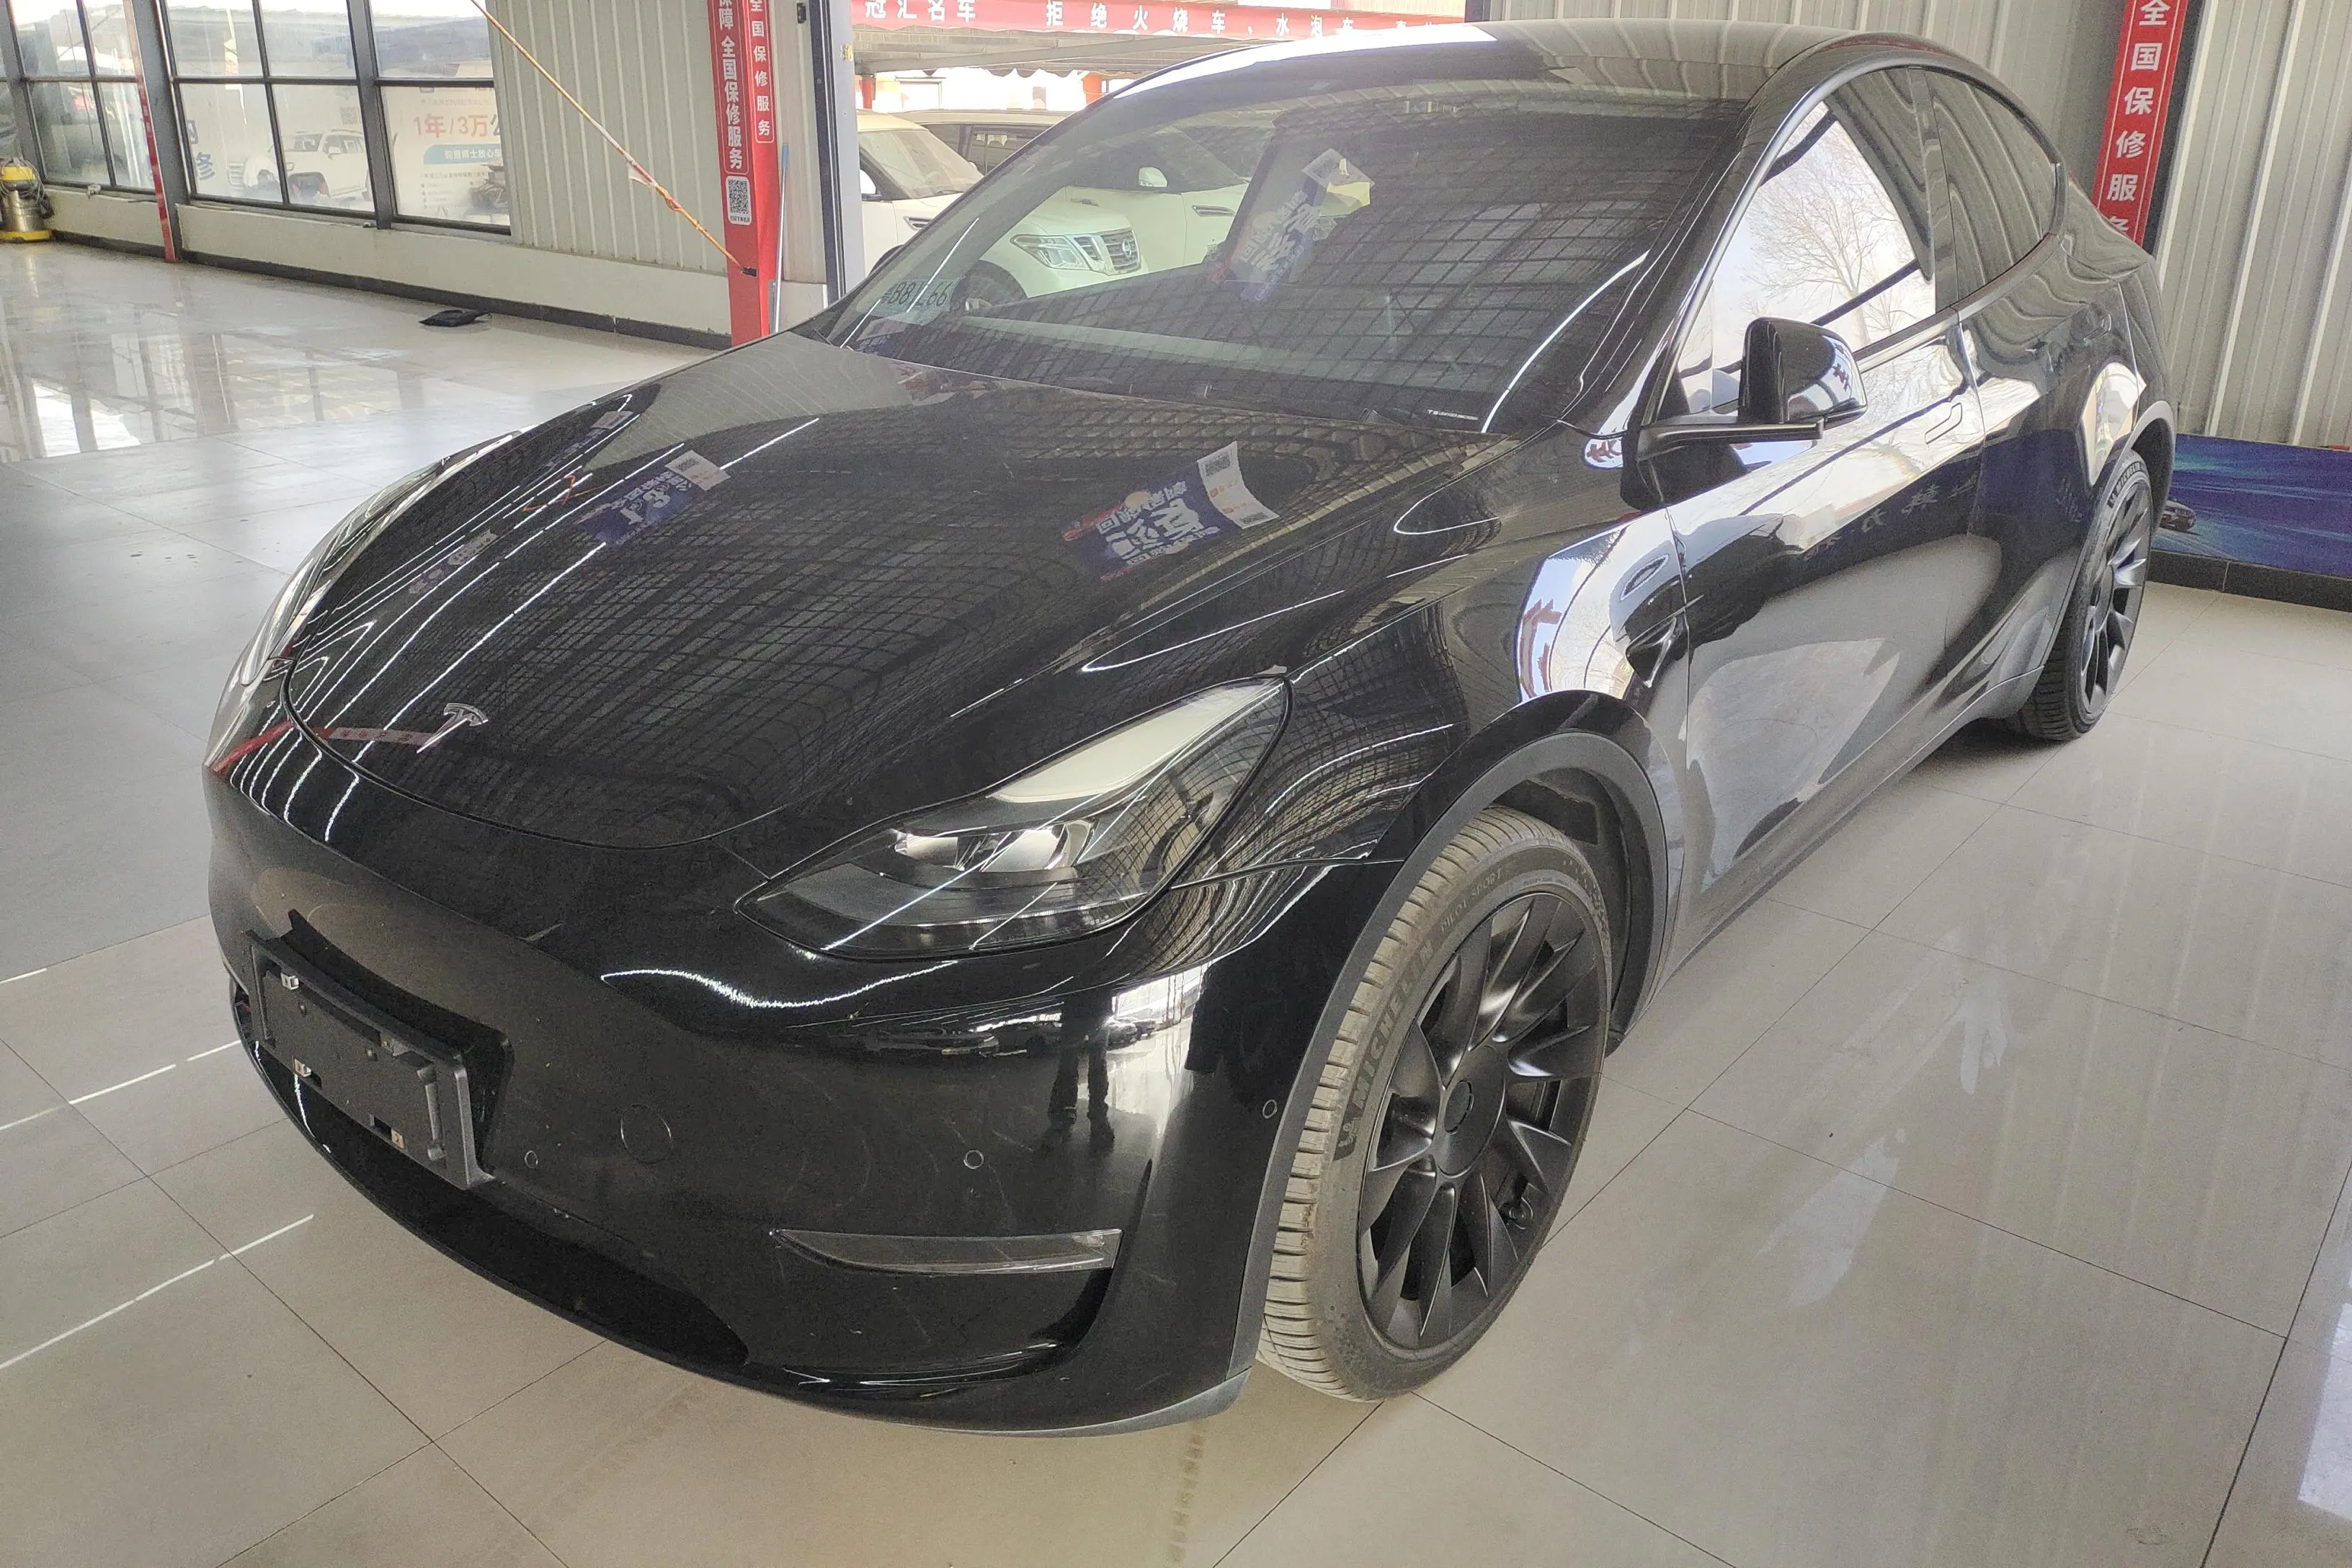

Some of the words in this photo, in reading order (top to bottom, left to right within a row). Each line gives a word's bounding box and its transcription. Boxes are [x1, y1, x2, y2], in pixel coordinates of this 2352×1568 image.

[750, 0, 770, 136] 全国保修服务
[864, 0, 976, 23] 冠汇名车
[721, 35, 743, 169] 全国保修服务
